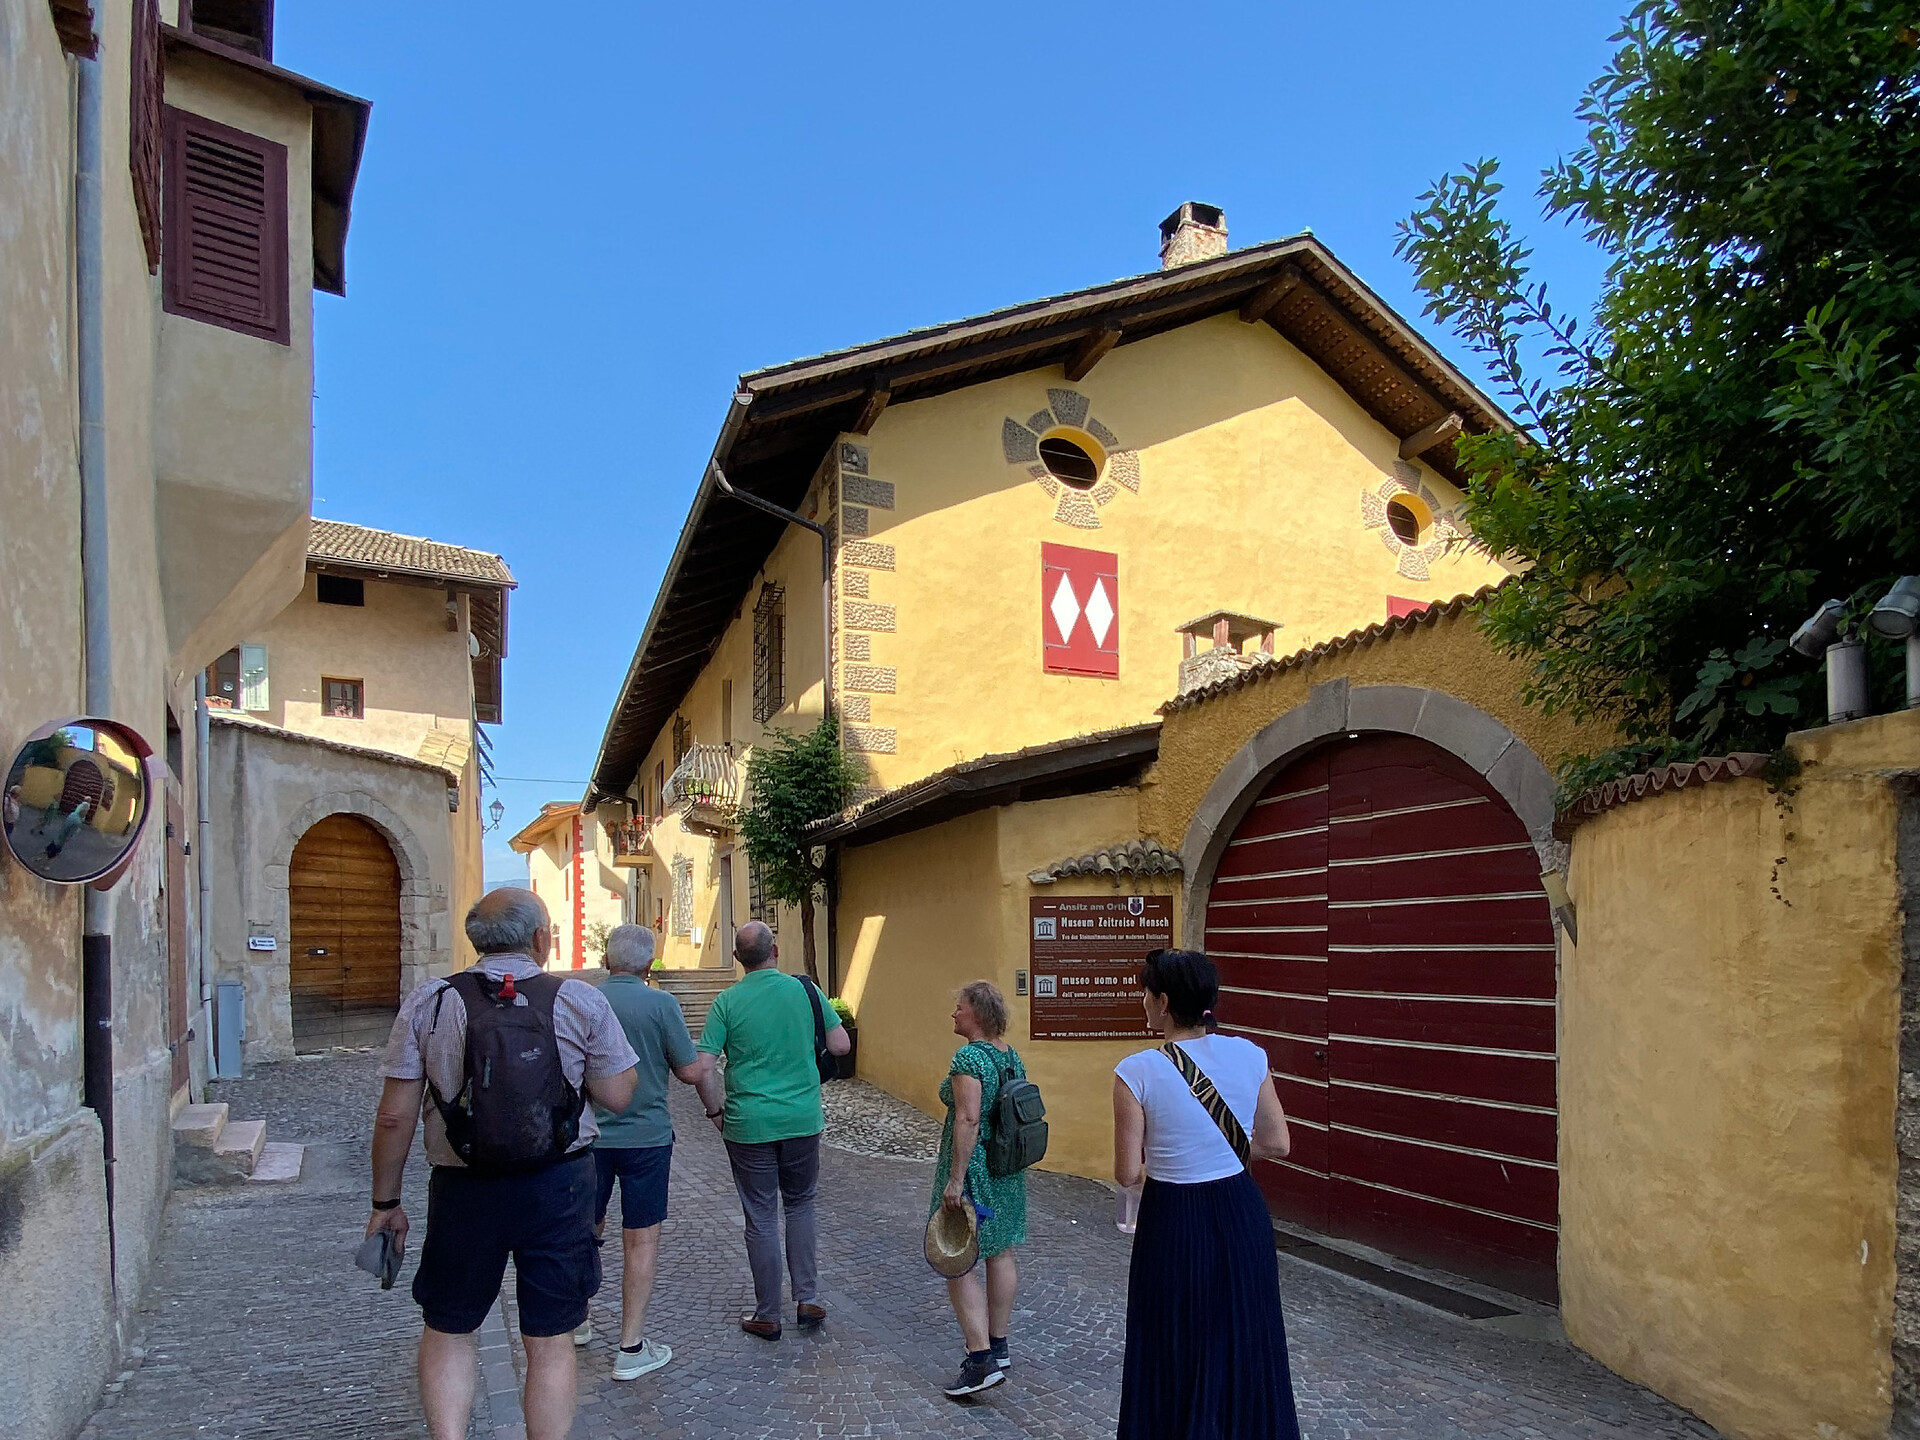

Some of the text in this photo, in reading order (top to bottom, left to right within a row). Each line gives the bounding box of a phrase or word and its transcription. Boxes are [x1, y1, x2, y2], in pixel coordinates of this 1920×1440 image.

[1059, 903, 1088, 911] Ansitz
[1106, 903, 1127, 911] Orth
[1061, 917, 1169, 927] Museum Zeitreise Mensch
[1061, 974, 1137, 985] museo uomo nel
